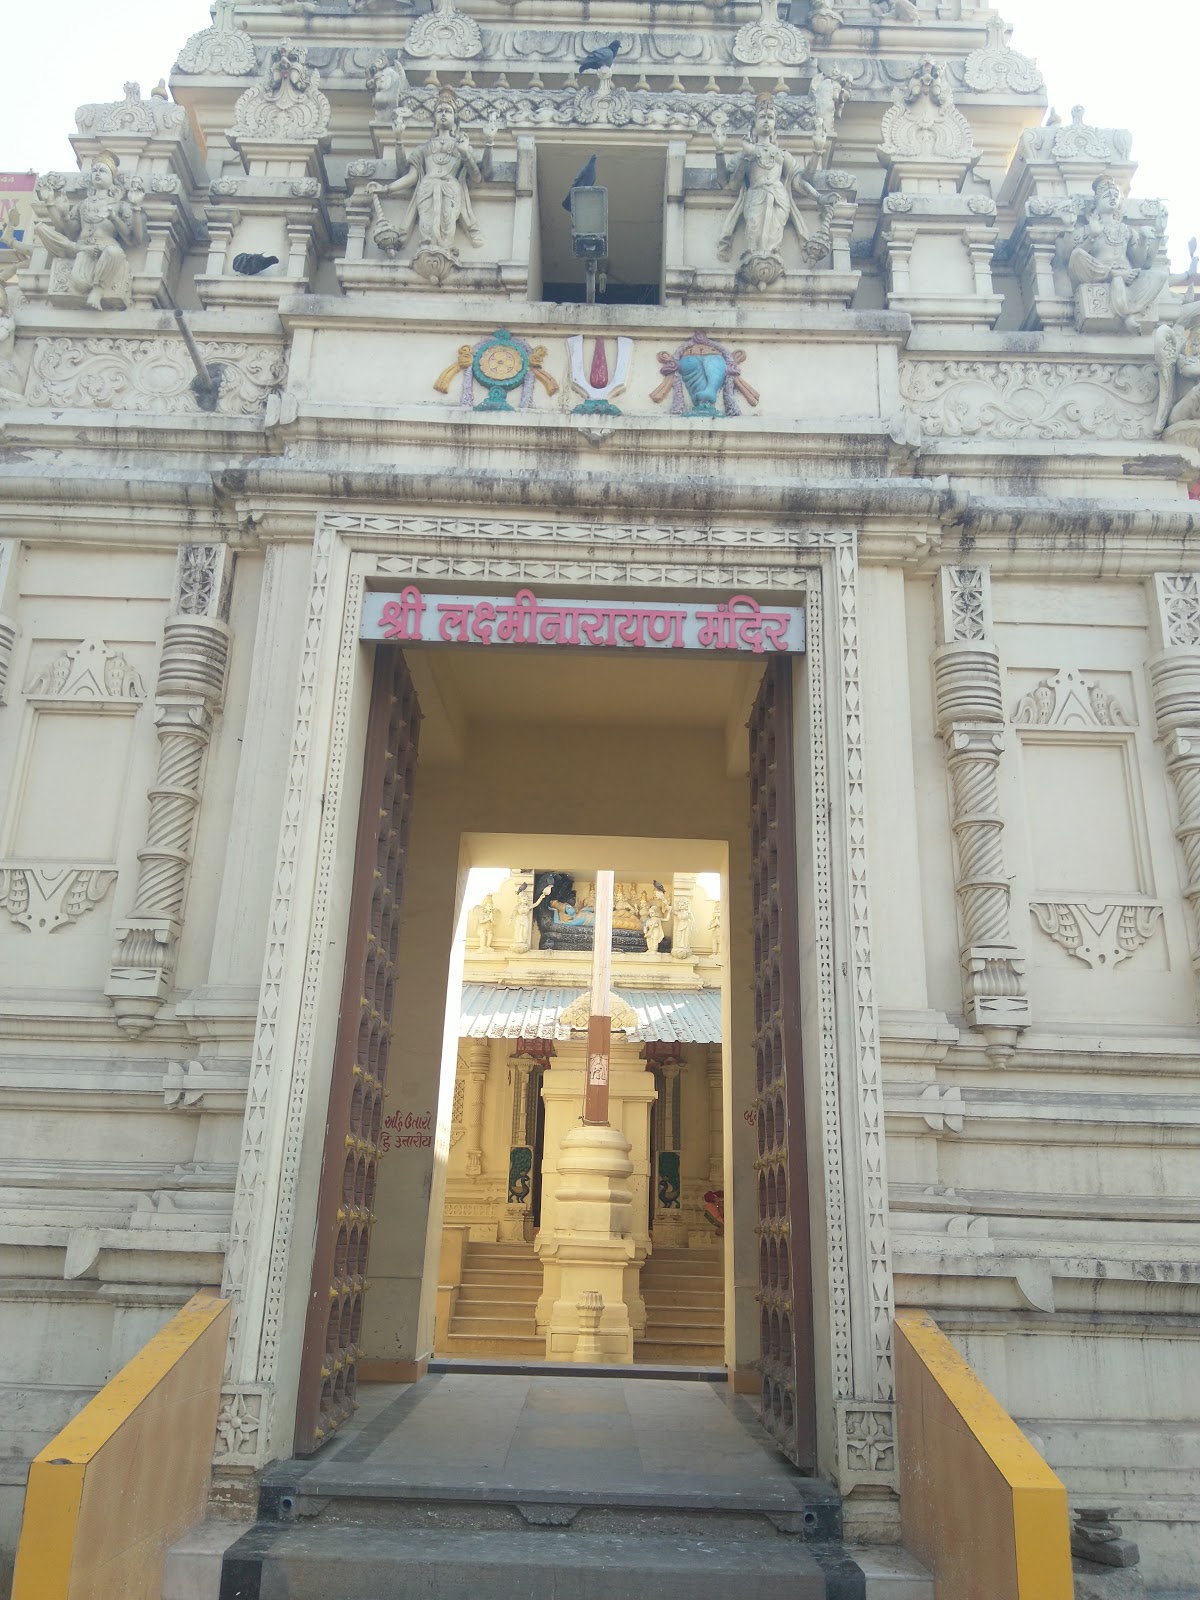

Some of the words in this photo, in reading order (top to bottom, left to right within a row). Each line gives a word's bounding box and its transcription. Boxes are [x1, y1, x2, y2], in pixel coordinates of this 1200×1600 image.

[377, 585, 426, 639] श्री
[437, 588, 688, 648] लक्ष्मीनारायण
[695, 594, 791, 653] मंदिर
